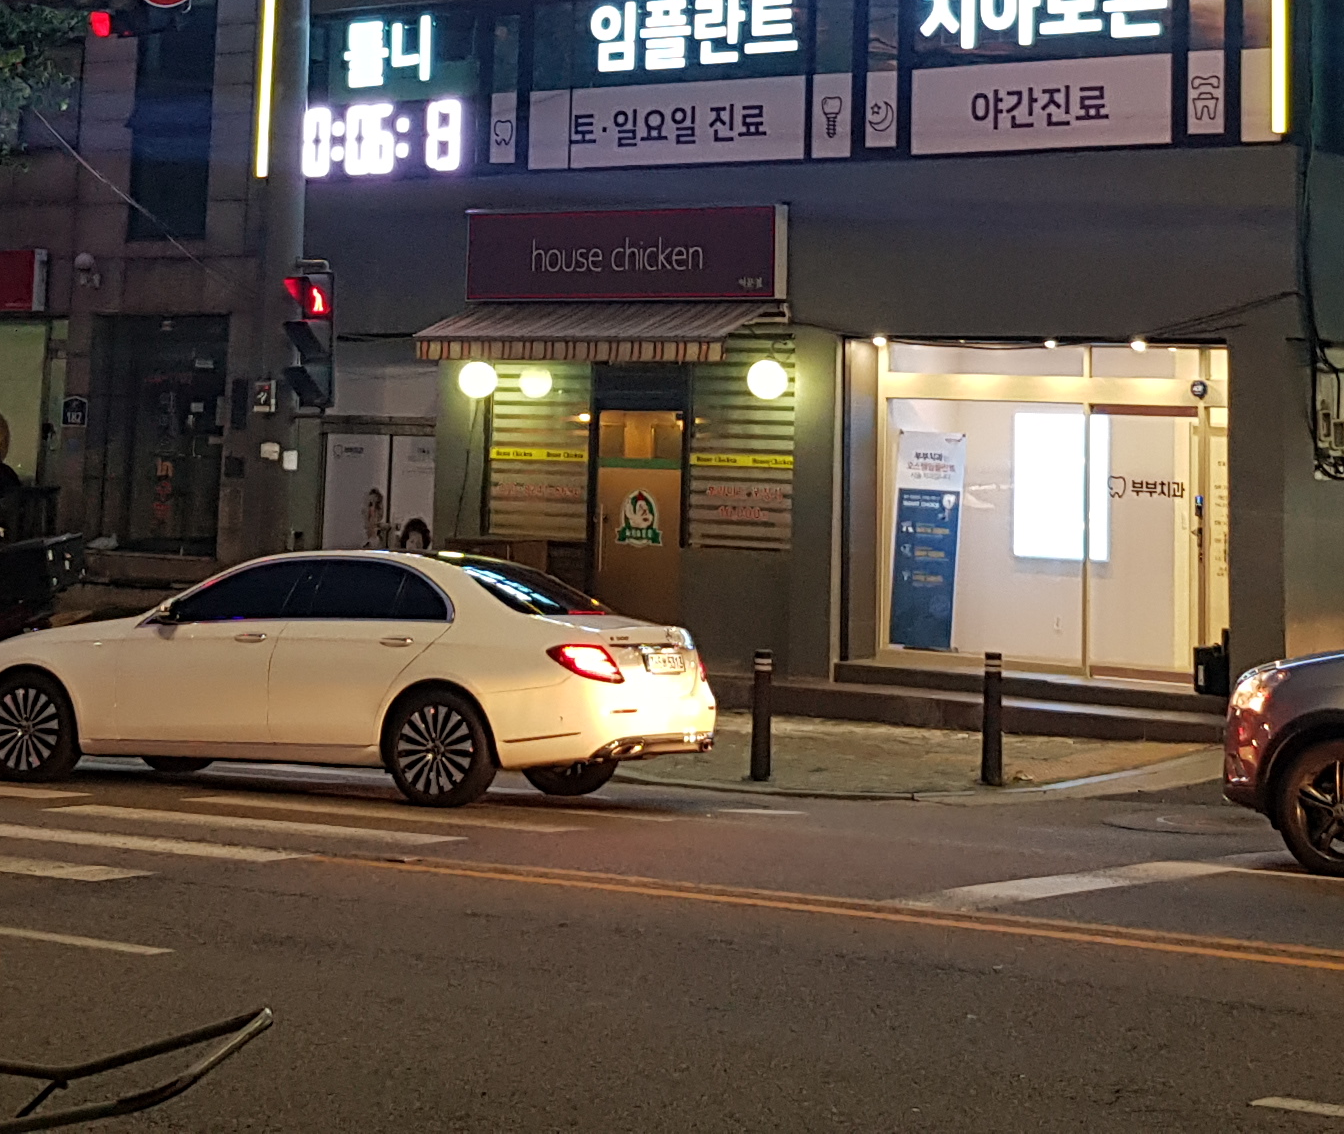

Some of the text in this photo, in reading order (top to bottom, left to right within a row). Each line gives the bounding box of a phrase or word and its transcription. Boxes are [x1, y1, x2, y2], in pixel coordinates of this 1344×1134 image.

[707, 103, 769, 143] 진료
[969, 83, 1111, 132] 야간진료
[531, 236, 704, 272] house chicken
[1131, 479, 1186, 499] 부부치과
